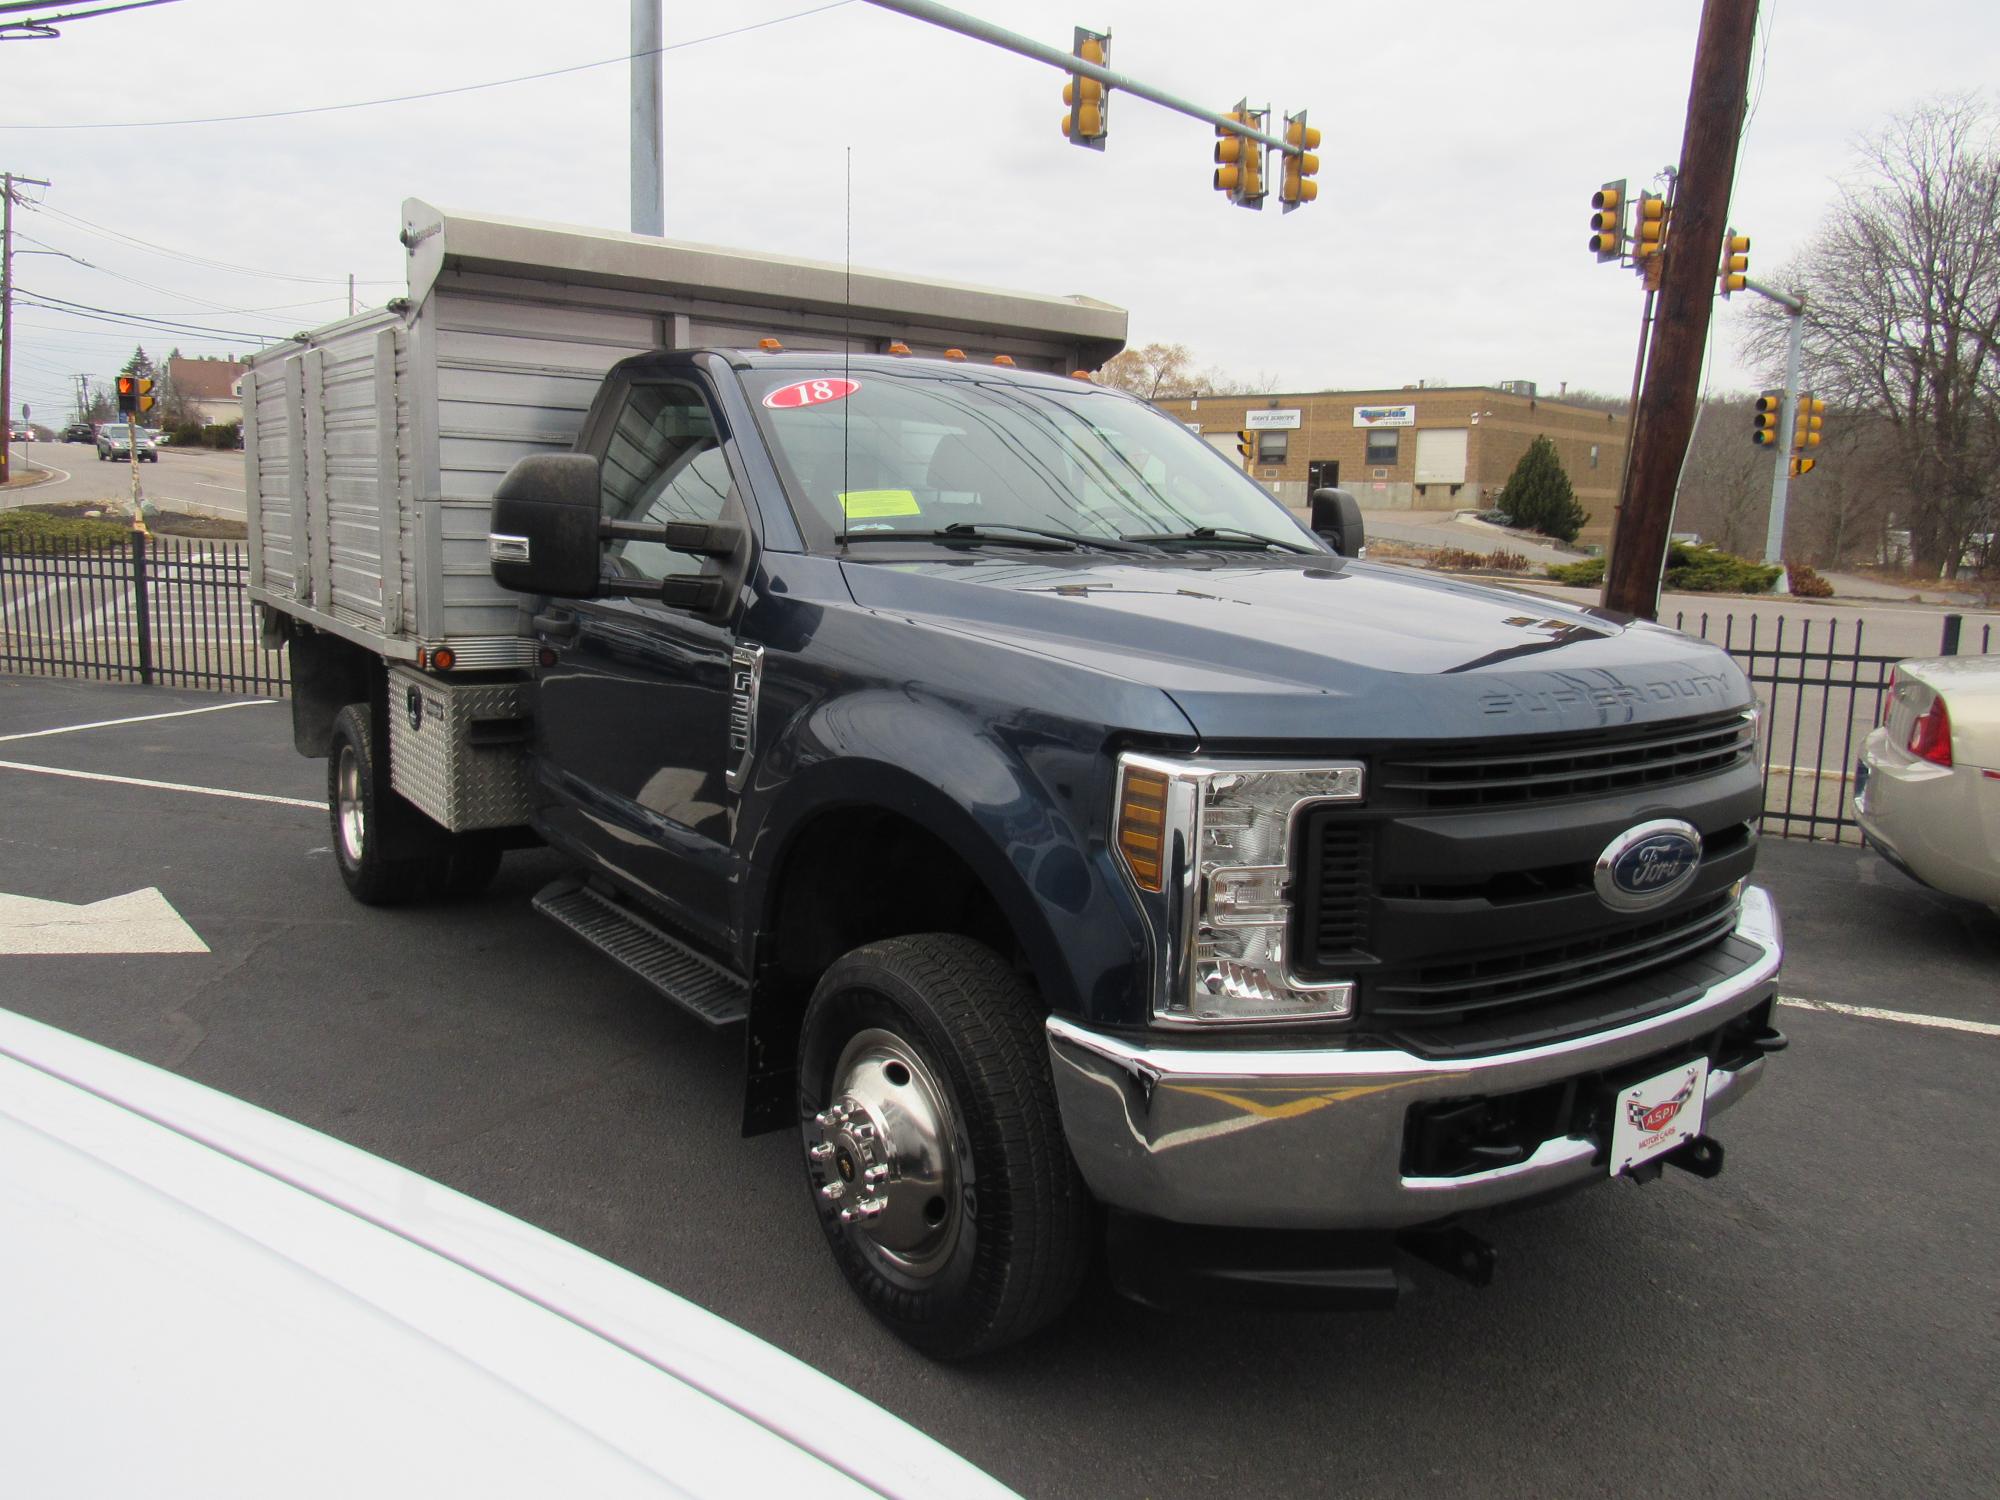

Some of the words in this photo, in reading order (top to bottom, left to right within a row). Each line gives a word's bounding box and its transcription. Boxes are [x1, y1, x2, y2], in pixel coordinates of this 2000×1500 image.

[795, 381, 833, 406] 18
[1479, 685, 1647, 715] SUPER
[1648, 673, 1729, 701] DUTY
[1632, 844, 1683, 885] Ford
[1638, 1133, 1659, 1149] MOTOR
[1660, 1126, 1676, 1139] CARS
